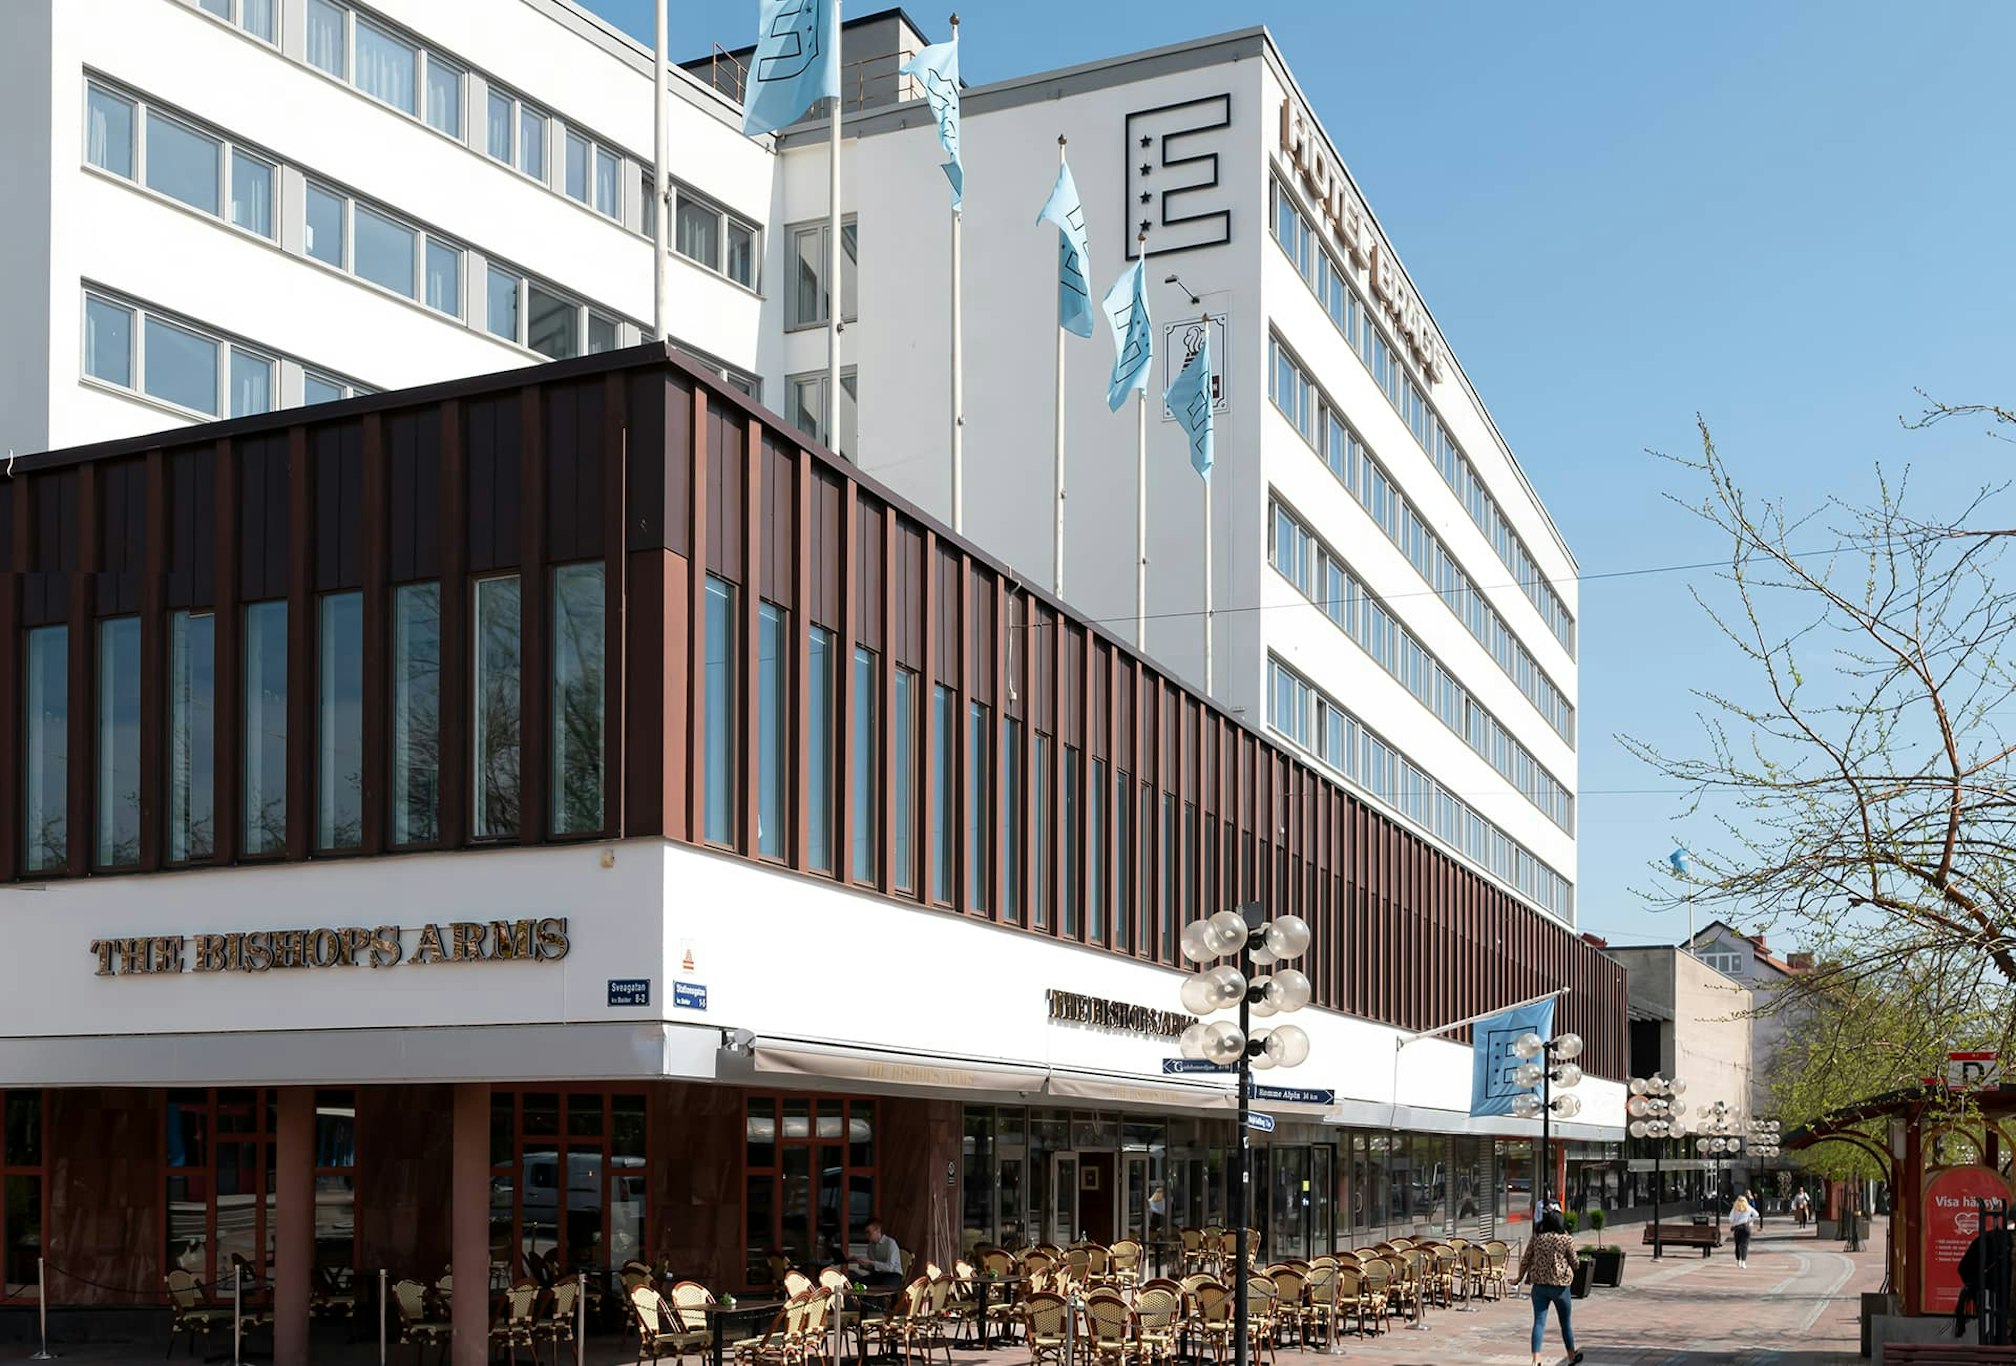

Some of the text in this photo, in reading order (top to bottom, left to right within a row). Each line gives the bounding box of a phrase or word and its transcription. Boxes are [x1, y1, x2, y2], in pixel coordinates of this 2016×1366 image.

[1281, 97, 1443, 384] HOTEL BRAGE
[90, 917, 569, 976] THE BISHOPS ARMS
[611, 982, 646, 994] Sveagatan
[1045, 987, 1087, 1022] THE
[1089, 995, 1157, 1036] BISHOPS
[1282, 1089, 1301, 1101] Alpin
[1935, 1196, 2003, 1211] Visa häsyn
